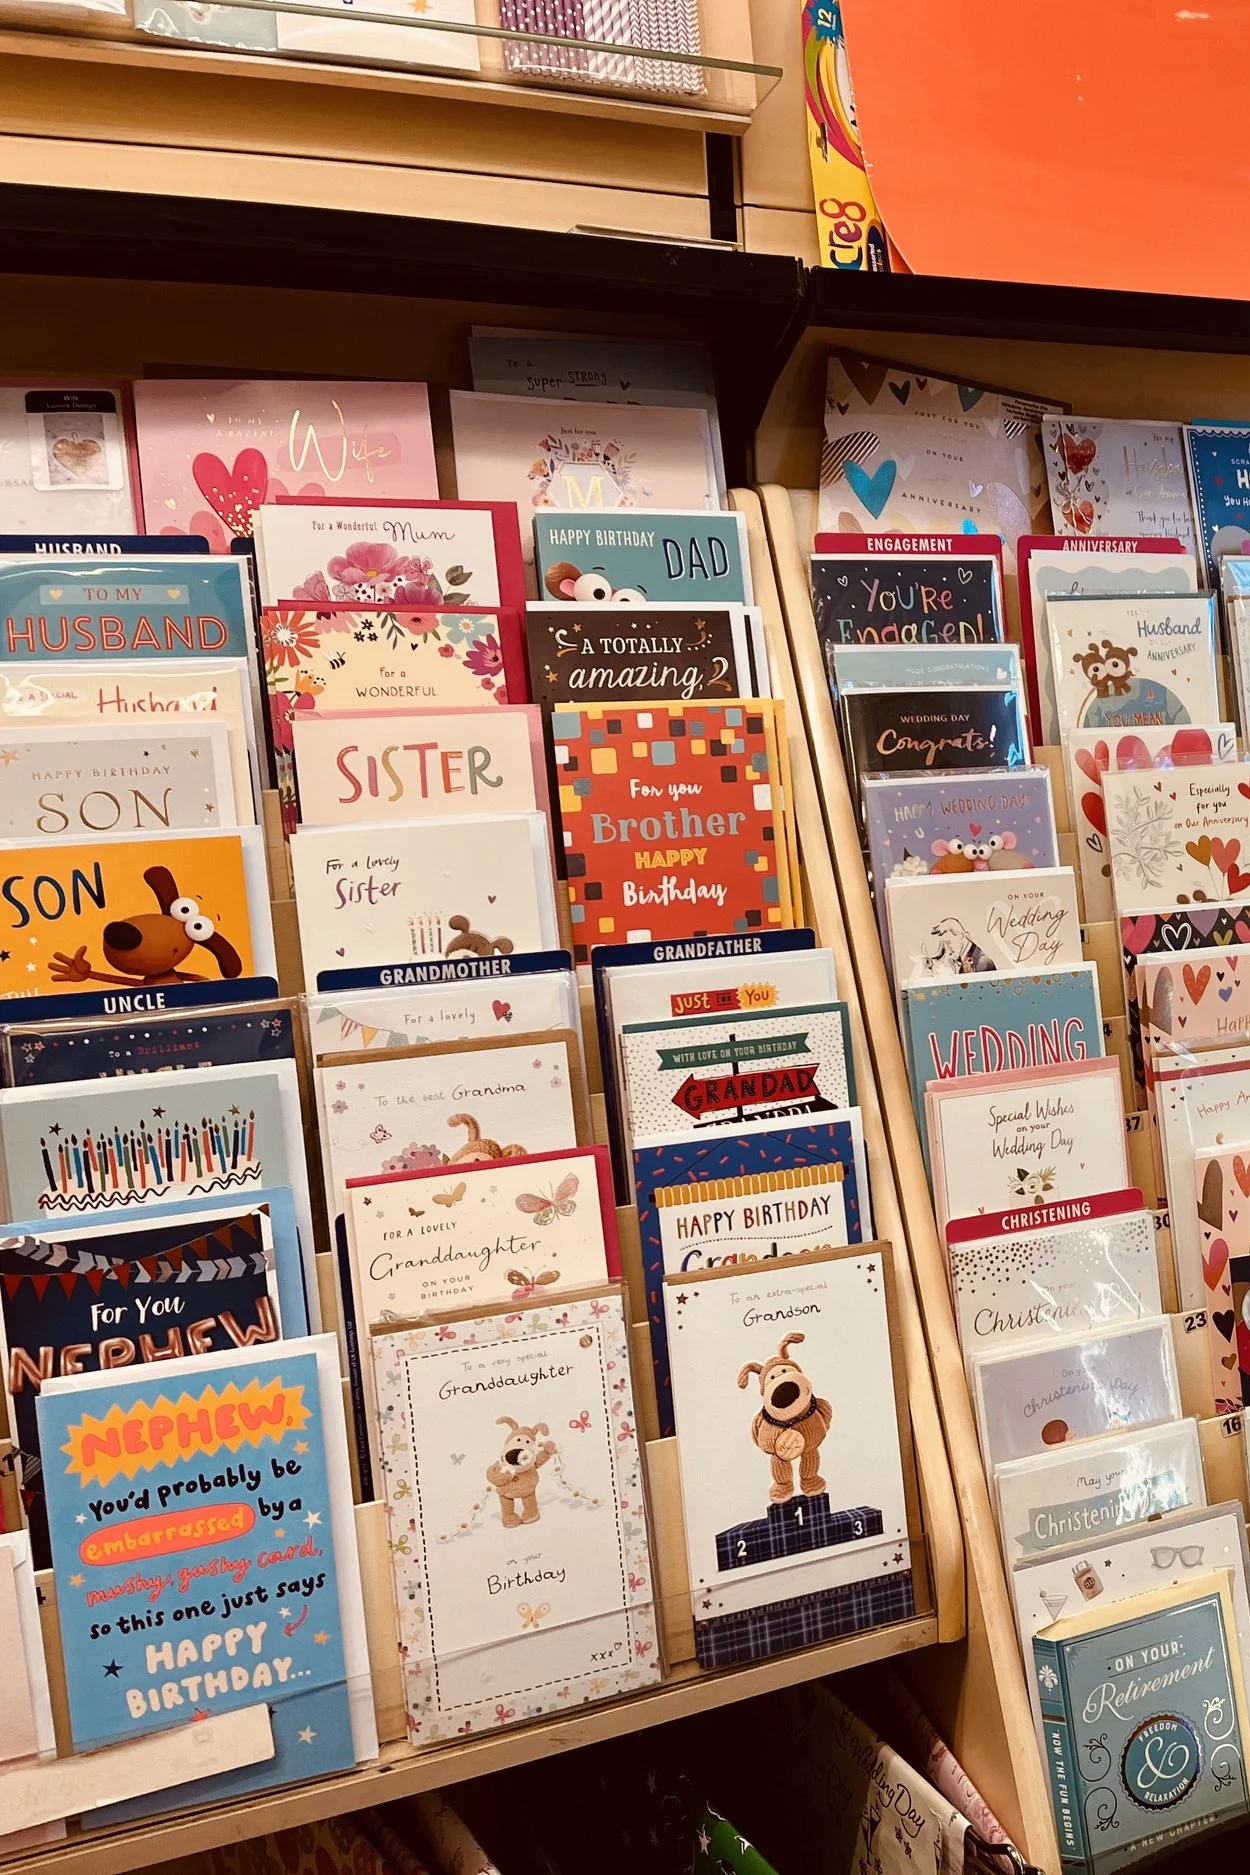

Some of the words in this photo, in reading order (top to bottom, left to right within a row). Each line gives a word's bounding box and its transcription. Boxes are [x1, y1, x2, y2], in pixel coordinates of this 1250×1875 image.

[817, 8, 833, 28] 12
[289, 400, 393, 484] Wife
[312, 520, 325, 532] For
[327, 523, 333, 532] a
[336, 520, 378, 532] Wonderful
[382, 518, 456, 544] Mum
[549, 528, 592, 547] HAPPY
[595, 528, 656, 549] BIRTHDAY
[866, 537, 954, 552] ENGAGEMENT
[1062, 539, 1138, 554] ANNIVERSARY
[661, 536, 730, 581] DAD
[83, 587, 110, 601] TO
[115, 586, 145, 601] MY
[7, 615, 229, 653] HUSBAND
[1136, 617, 1202, 638] Husband
[580, 637, 595, 655] A
[600, 636, 684, 655] TOTALLY
[355, 684, 438, 699] WONDERFUL
[900, 713, 948, 724] WEDDING
[950, 713, 970, 723] DAY
[875, 723, 997, 766] Congrats!
[31, 767, 83, 781] HAPPY
[92, 764, 172, 779] BIRTHDAY
[336, 742, 504, 804] SISTER
[35, 787, 173, 834] SON
[590, 807, 747, 844] Brother
[634, 847, 708, 870] HAPPY
[1, 861, 107, 929] SON
[334, 874, 402, 910] Sister
[622, 876, 728, 907] Birthday
[1007, 892, 1019, 901] ON
[1022, 891, 1045, 900] YOUR
[985, 903, 1069, 937] Wedding
[653, 937, 763, 961] GRANDFATHER
[1011, 930, 1063, 967] Day
[379, 957, 512, 986] GRANDMOTHER
[103, 992, 166, 1015] UNCLE
[672, 1051, 695, 1064] WITH
[697, 1049, 718, 1062] LOVE
[719, 1047, 732, 1059] ON
[733, 1045, 756, 1058] YOUR
[757, 1040, 797, 1056] BIRTHDAY
[928, 1017, 1087, 1079] WEDDING
[683, 1069, 815, 1112] GRANDAD
[987, 1106, 1032, 1129] Special
[1034, 1096, 1076, 1119] Wishes
[1015, 1125, 1027, 1134] on
[1028, 1121, 1051, 1134] your
[991, 1137, 1045, 1160] Wedding
[1050, 1127, 1075, 1155] Day
[675, 1208, 737, 1240] HAPPY
[742, 1194, 831, 1231] BIRTHDAY
[1001, 1200, 1092, 1232] CHRISTENING
[369, 1234, 541, 1282] Granddaughter
[90, 1302, 128, 1332] For
[134, 1295, 186, 1325] You
[742, 1302, 822, 1328] Grandson
[1184, 1311, 1207, 1332] 23
[8, 1296, 281, 1395] NEPHEW
[438, 1362, 574, 1400] Granddaughter
[81, 1393, 293, 1468] NEPHEW,
[88, 1489, 150, 1522] You'd
[157, 1463, 261, 1507] probably
[271, 1459, 302, 1481] be
[85, 1504, 244, 1563] embarrassed
[258, 1497, 286, 1521] by
[287, 1498, 302, 1513] a
[86, 1571, 175, 1608] mushy,
[178, 1554, 252, 1593] gushy
[257, 1536, 324, 1568] card,
[487, 1566, 567, 1596] Birthday
[90, 1621, 111, 1640] so
[115, 1609, 165, 1636] this
[171, 1598, 216, 1622] one
[220, 1587, 269, 1619] just
[275, 1572, 327, 1601] says
[145, 1621, 269, 1675] HAPPY
[1114, 1654, 1135, 1673] ON
[1139, 1644, 1180, 1664] YOUR
[125, 1656, 312, 1720] BIRTHDAY...
[1081, 1645, 1217, 1724] Retirement
[1138, 1720, 1179, 1742] FREEDOM
[1135, 1735, 1191, 1790] &
[1143, 1776, 1191, 1802] RELAXATION
